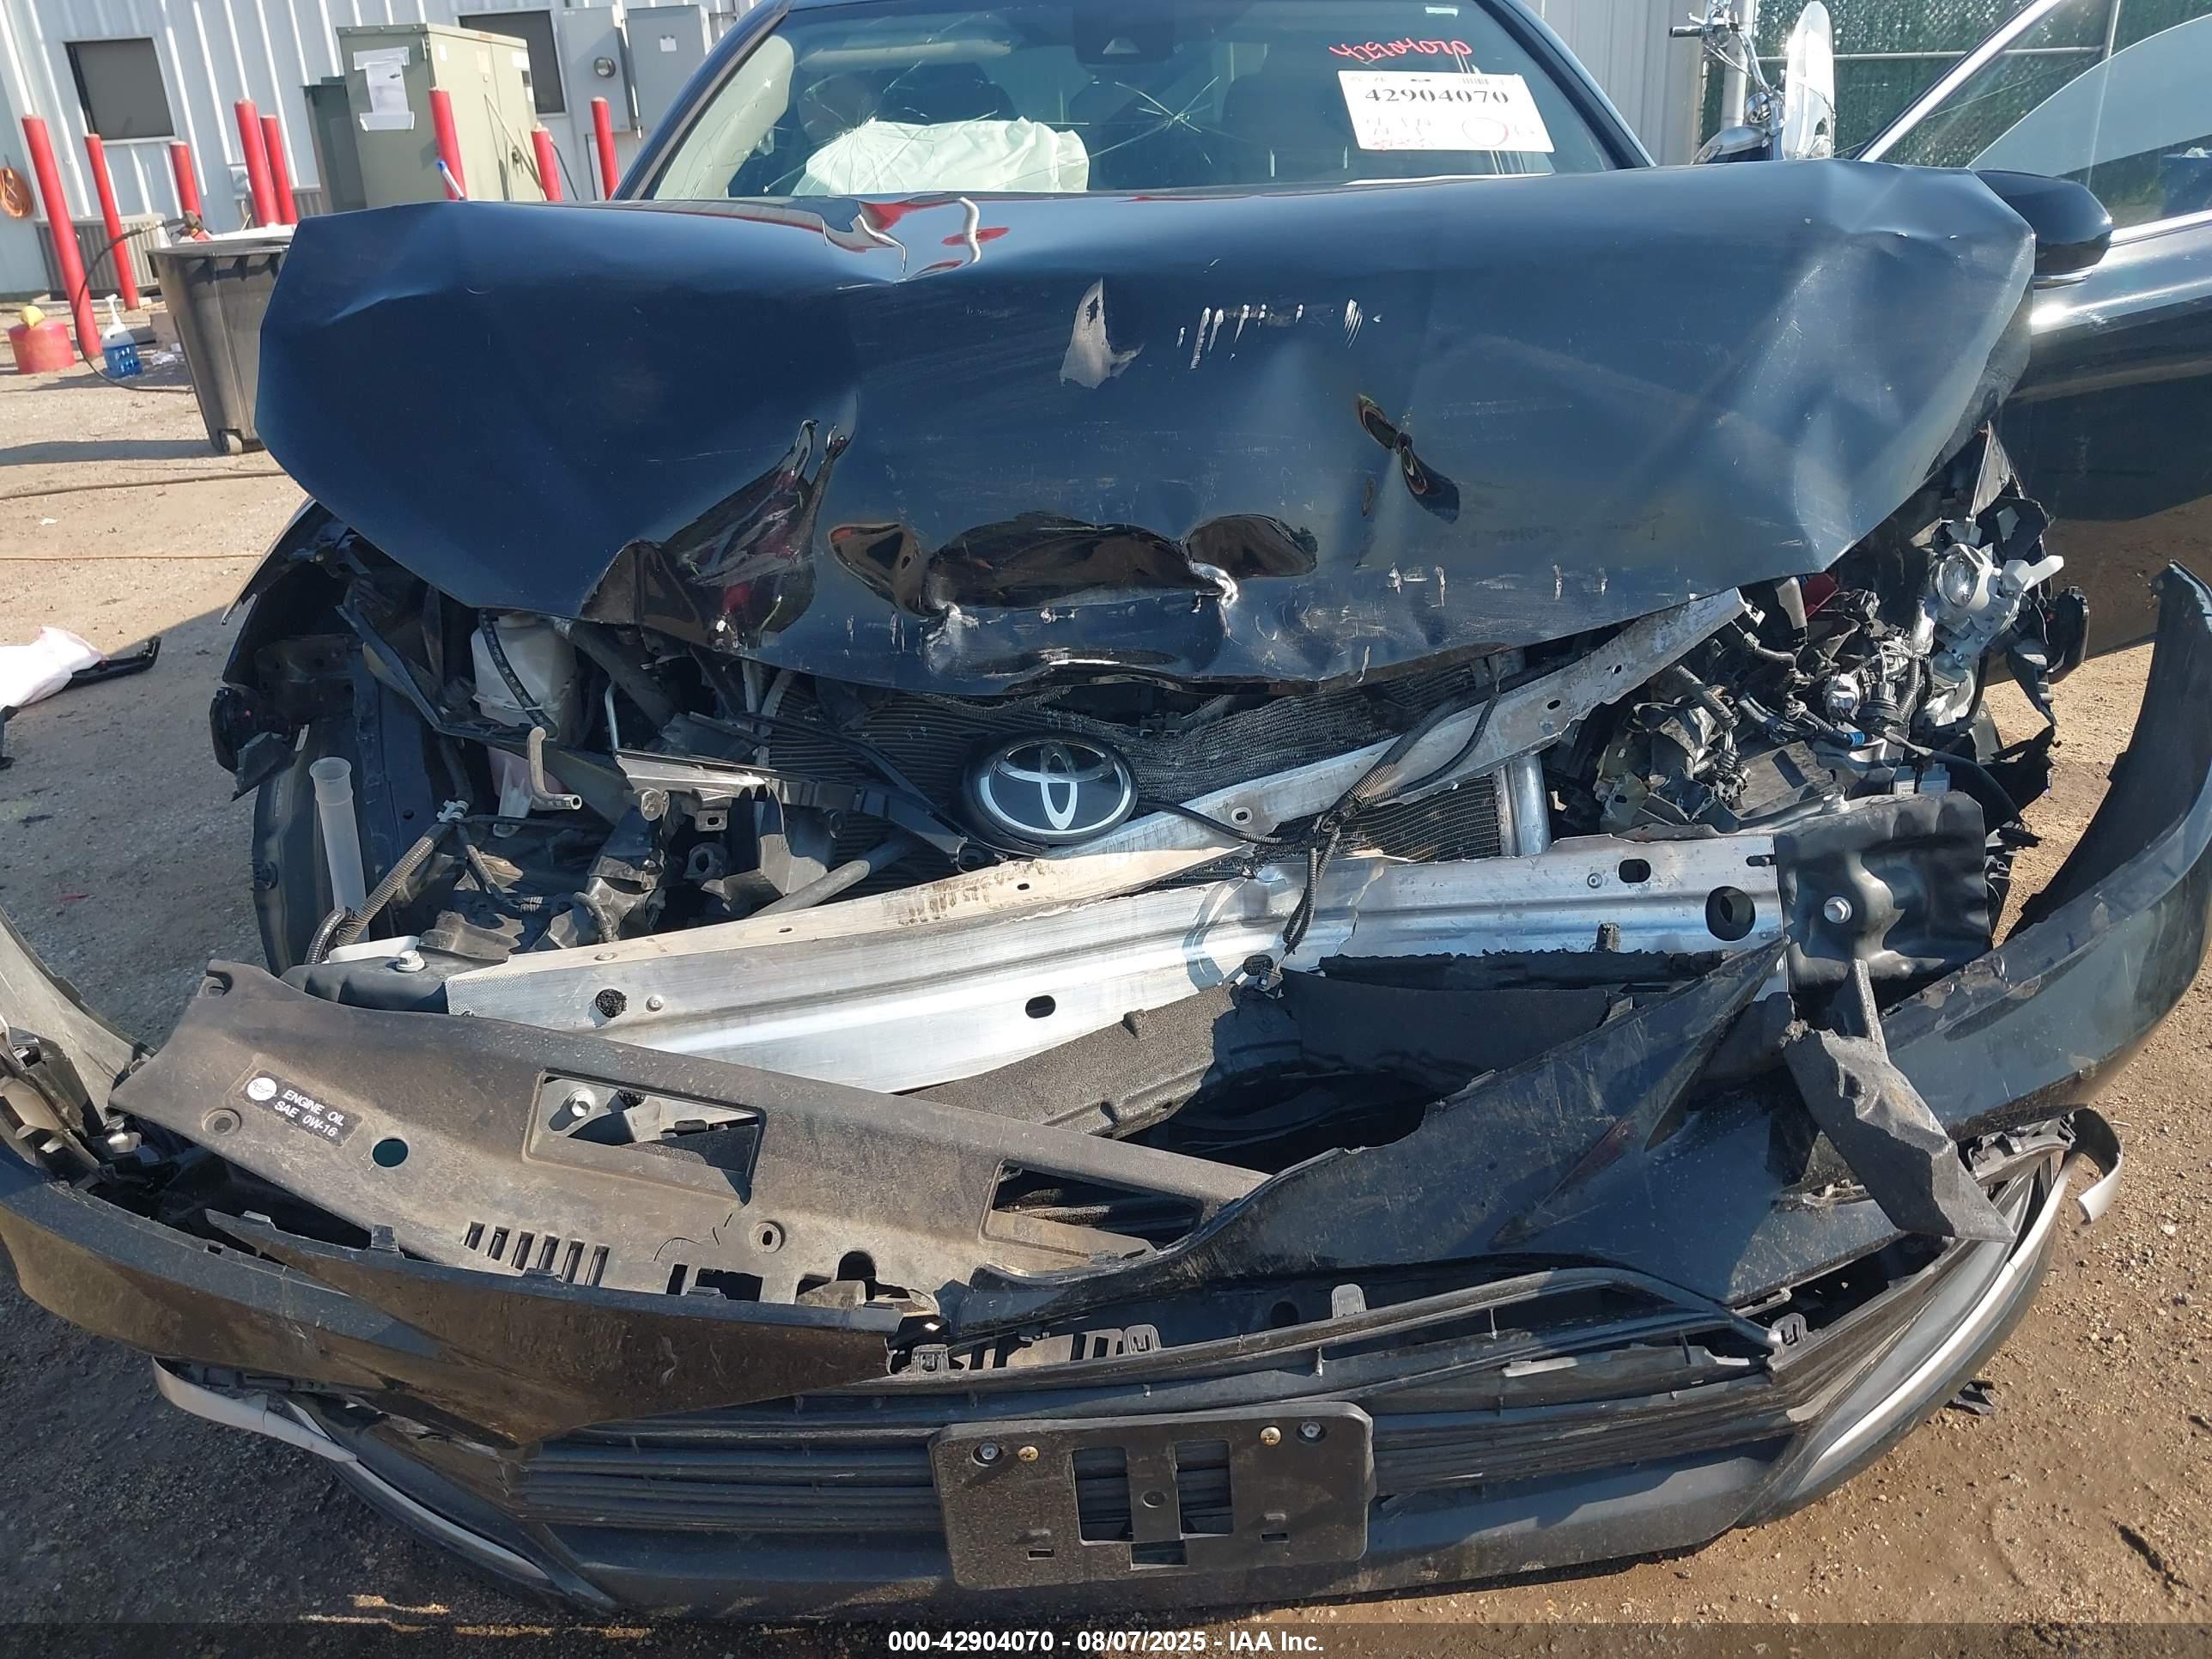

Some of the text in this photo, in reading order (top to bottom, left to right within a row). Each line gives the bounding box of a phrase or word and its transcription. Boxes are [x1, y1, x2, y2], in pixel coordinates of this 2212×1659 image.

[1328, 37, 1473, 61] 42904070
[1364, 88, 1510, 104] 42904070
[274, 1101, 338, 1137] SAE 0W-16
[283, 1090, 345, 1127] ENGINE OIL
